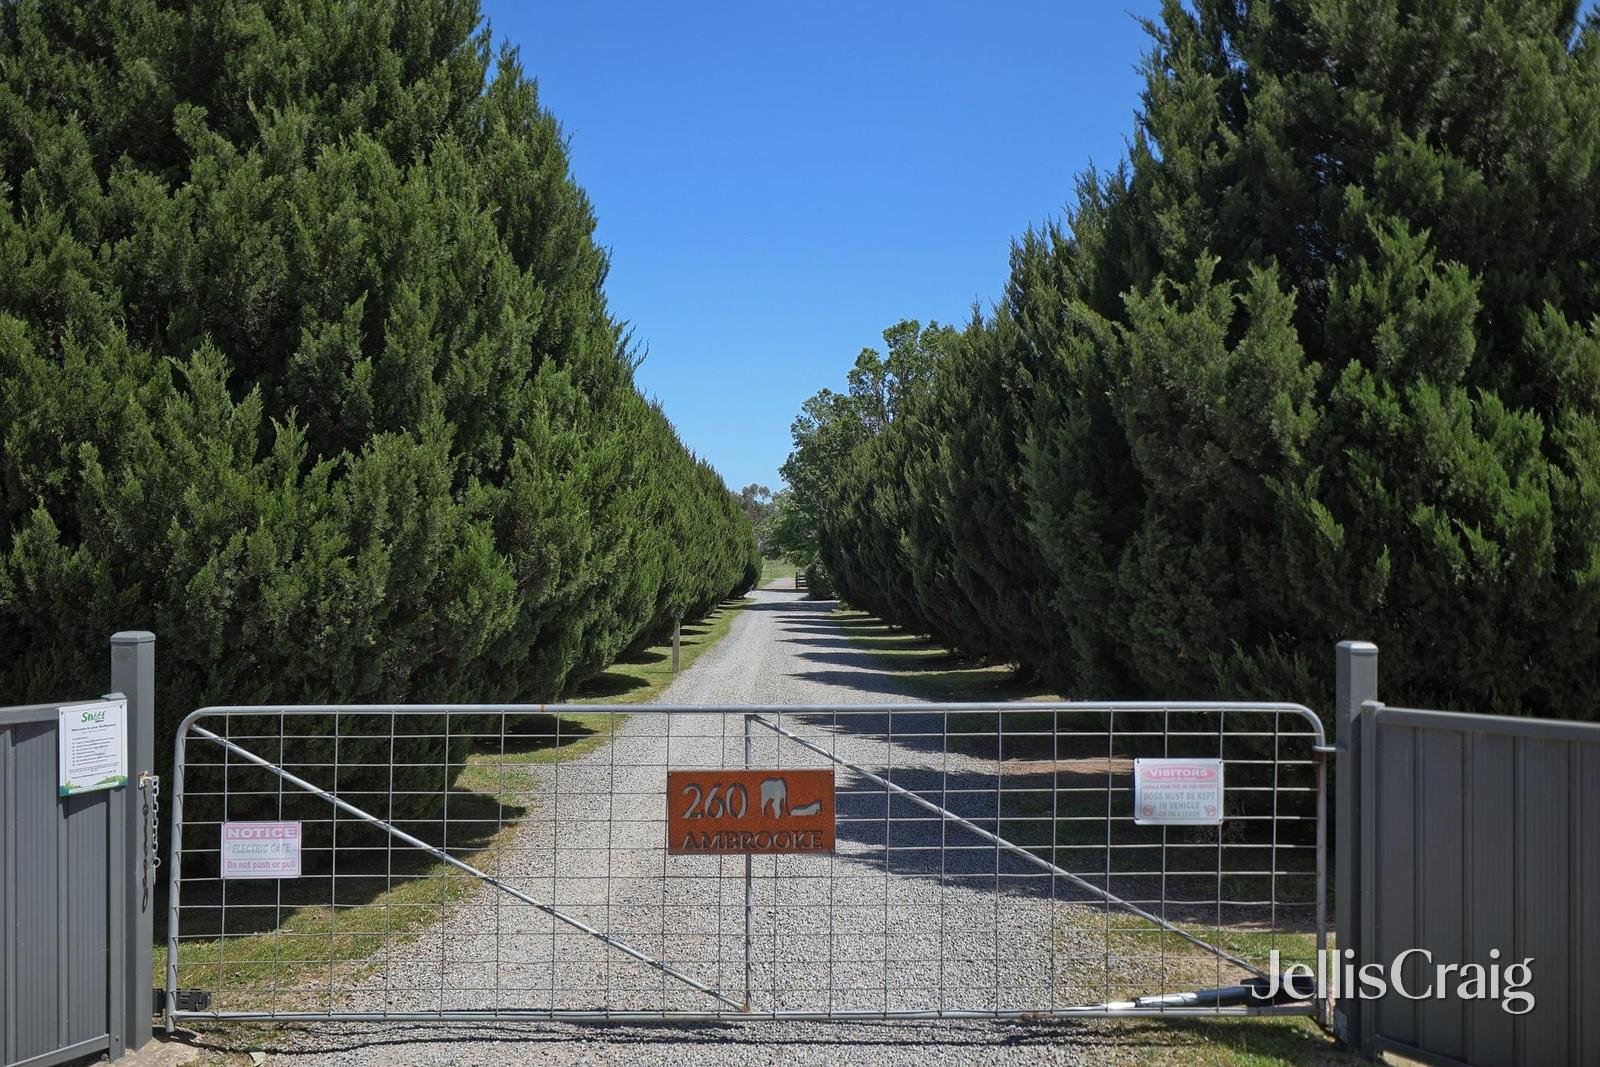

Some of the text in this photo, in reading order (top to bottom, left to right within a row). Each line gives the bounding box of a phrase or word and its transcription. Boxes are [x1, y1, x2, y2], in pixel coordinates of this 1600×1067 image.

[1149, 768, 1209, 777] VISITORS
[682, 782, 748, 819] 260
[1143, 792, 1216, 800] DOGS MUST BE KEPT
[1159, 802, 1200, 810] IN VEHICLE
[227, 828, 296, 838] NOTICE
[681, 830, 823, 850] AMBROOKE
[232, 843, 292, 854] ELECTRIC GATE
[253, 860, 270, 870] push
[282, 860, 296, 870] pull
